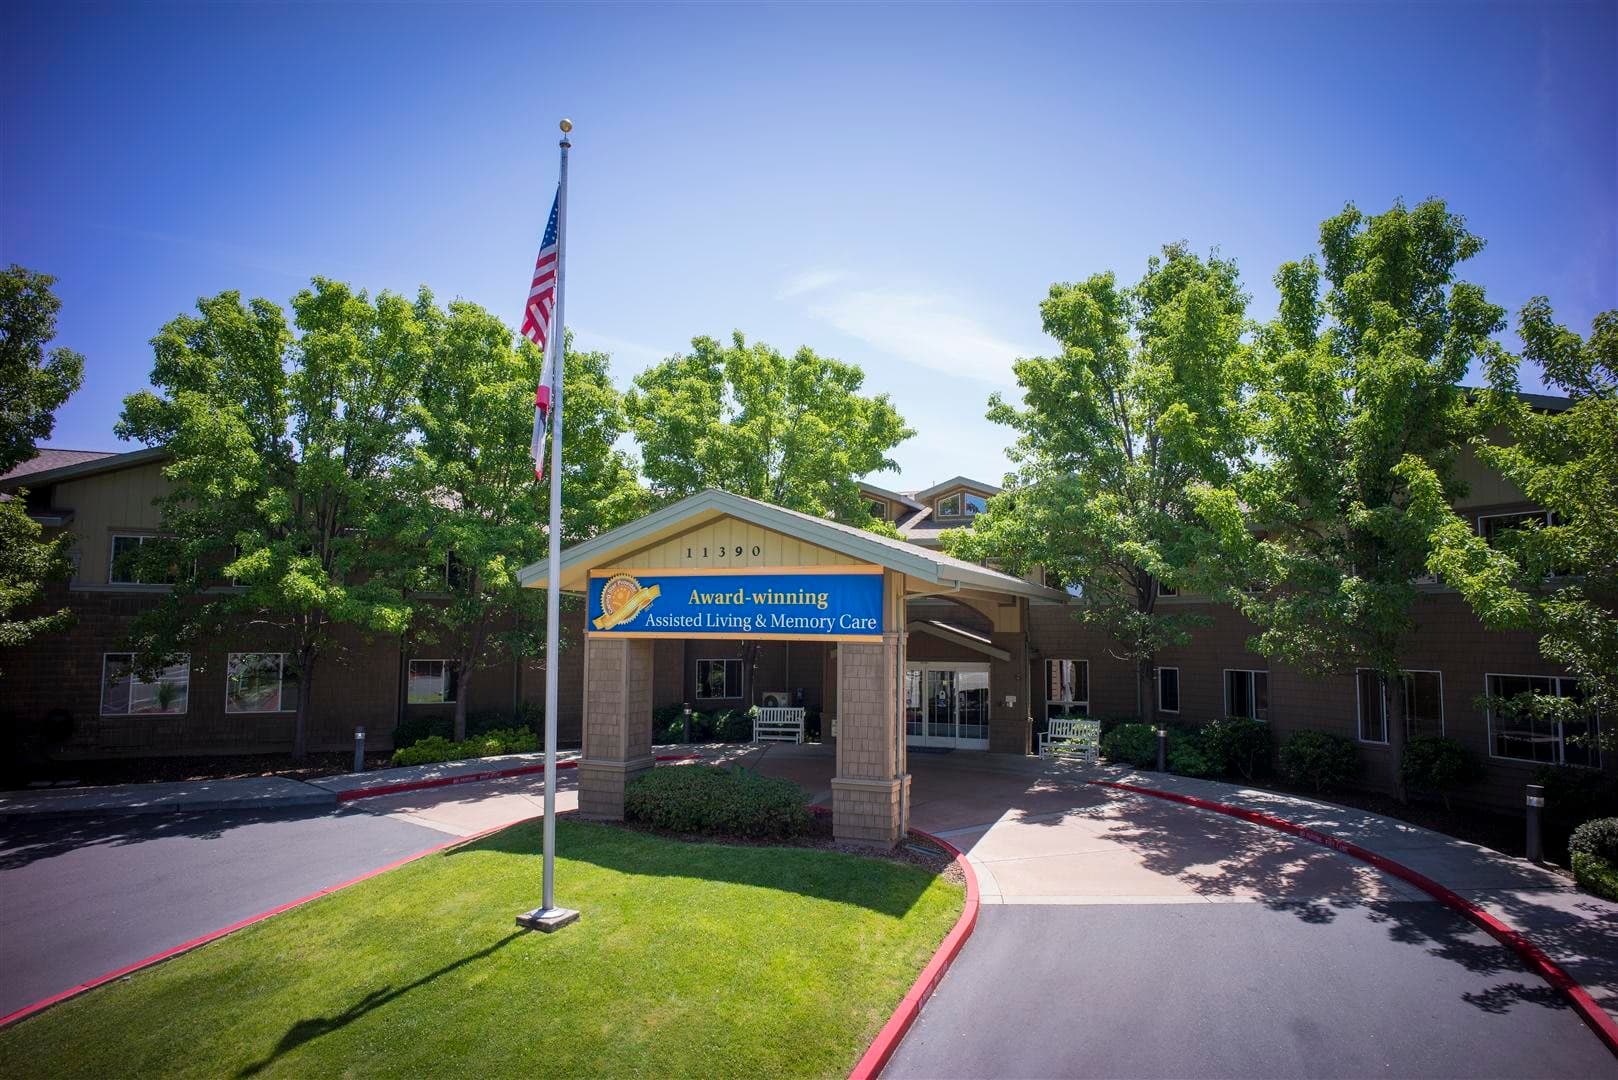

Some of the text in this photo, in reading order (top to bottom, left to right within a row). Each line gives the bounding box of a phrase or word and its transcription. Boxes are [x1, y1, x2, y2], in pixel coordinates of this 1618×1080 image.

[687, 545, 761, 559] 11390
[688, 588, 829, 610] Award-winning
[645, 612, 877, 633] Assisted Living & Memory Care
